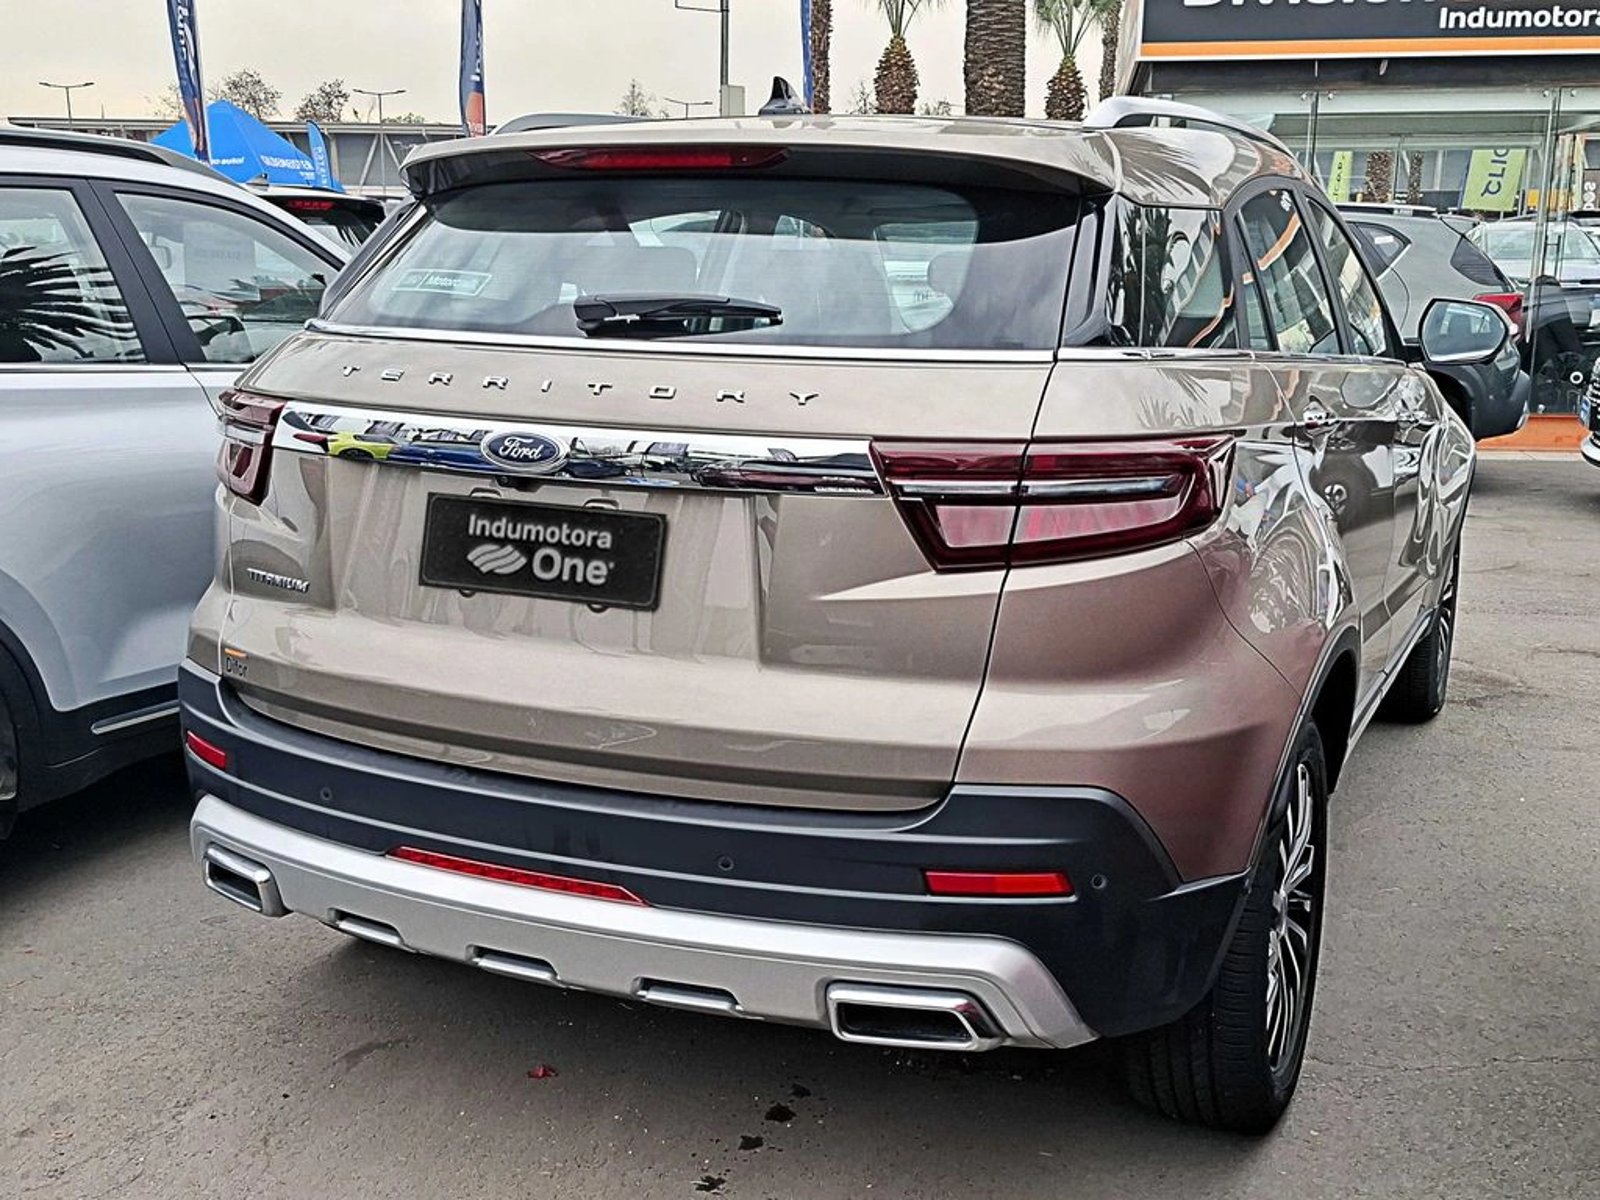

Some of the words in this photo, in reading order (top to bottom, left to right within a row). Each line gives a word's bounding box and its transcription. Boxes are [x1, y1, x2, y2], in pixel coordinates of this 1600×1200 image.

[342, 365, 819, 405] TERRITORY
[499, 436, 545, 460] Ford
[467, 513, 613, 549] Indumotora
[246, 567, 311, 593] TITANIUM
[531, 547, 609, 586] One
